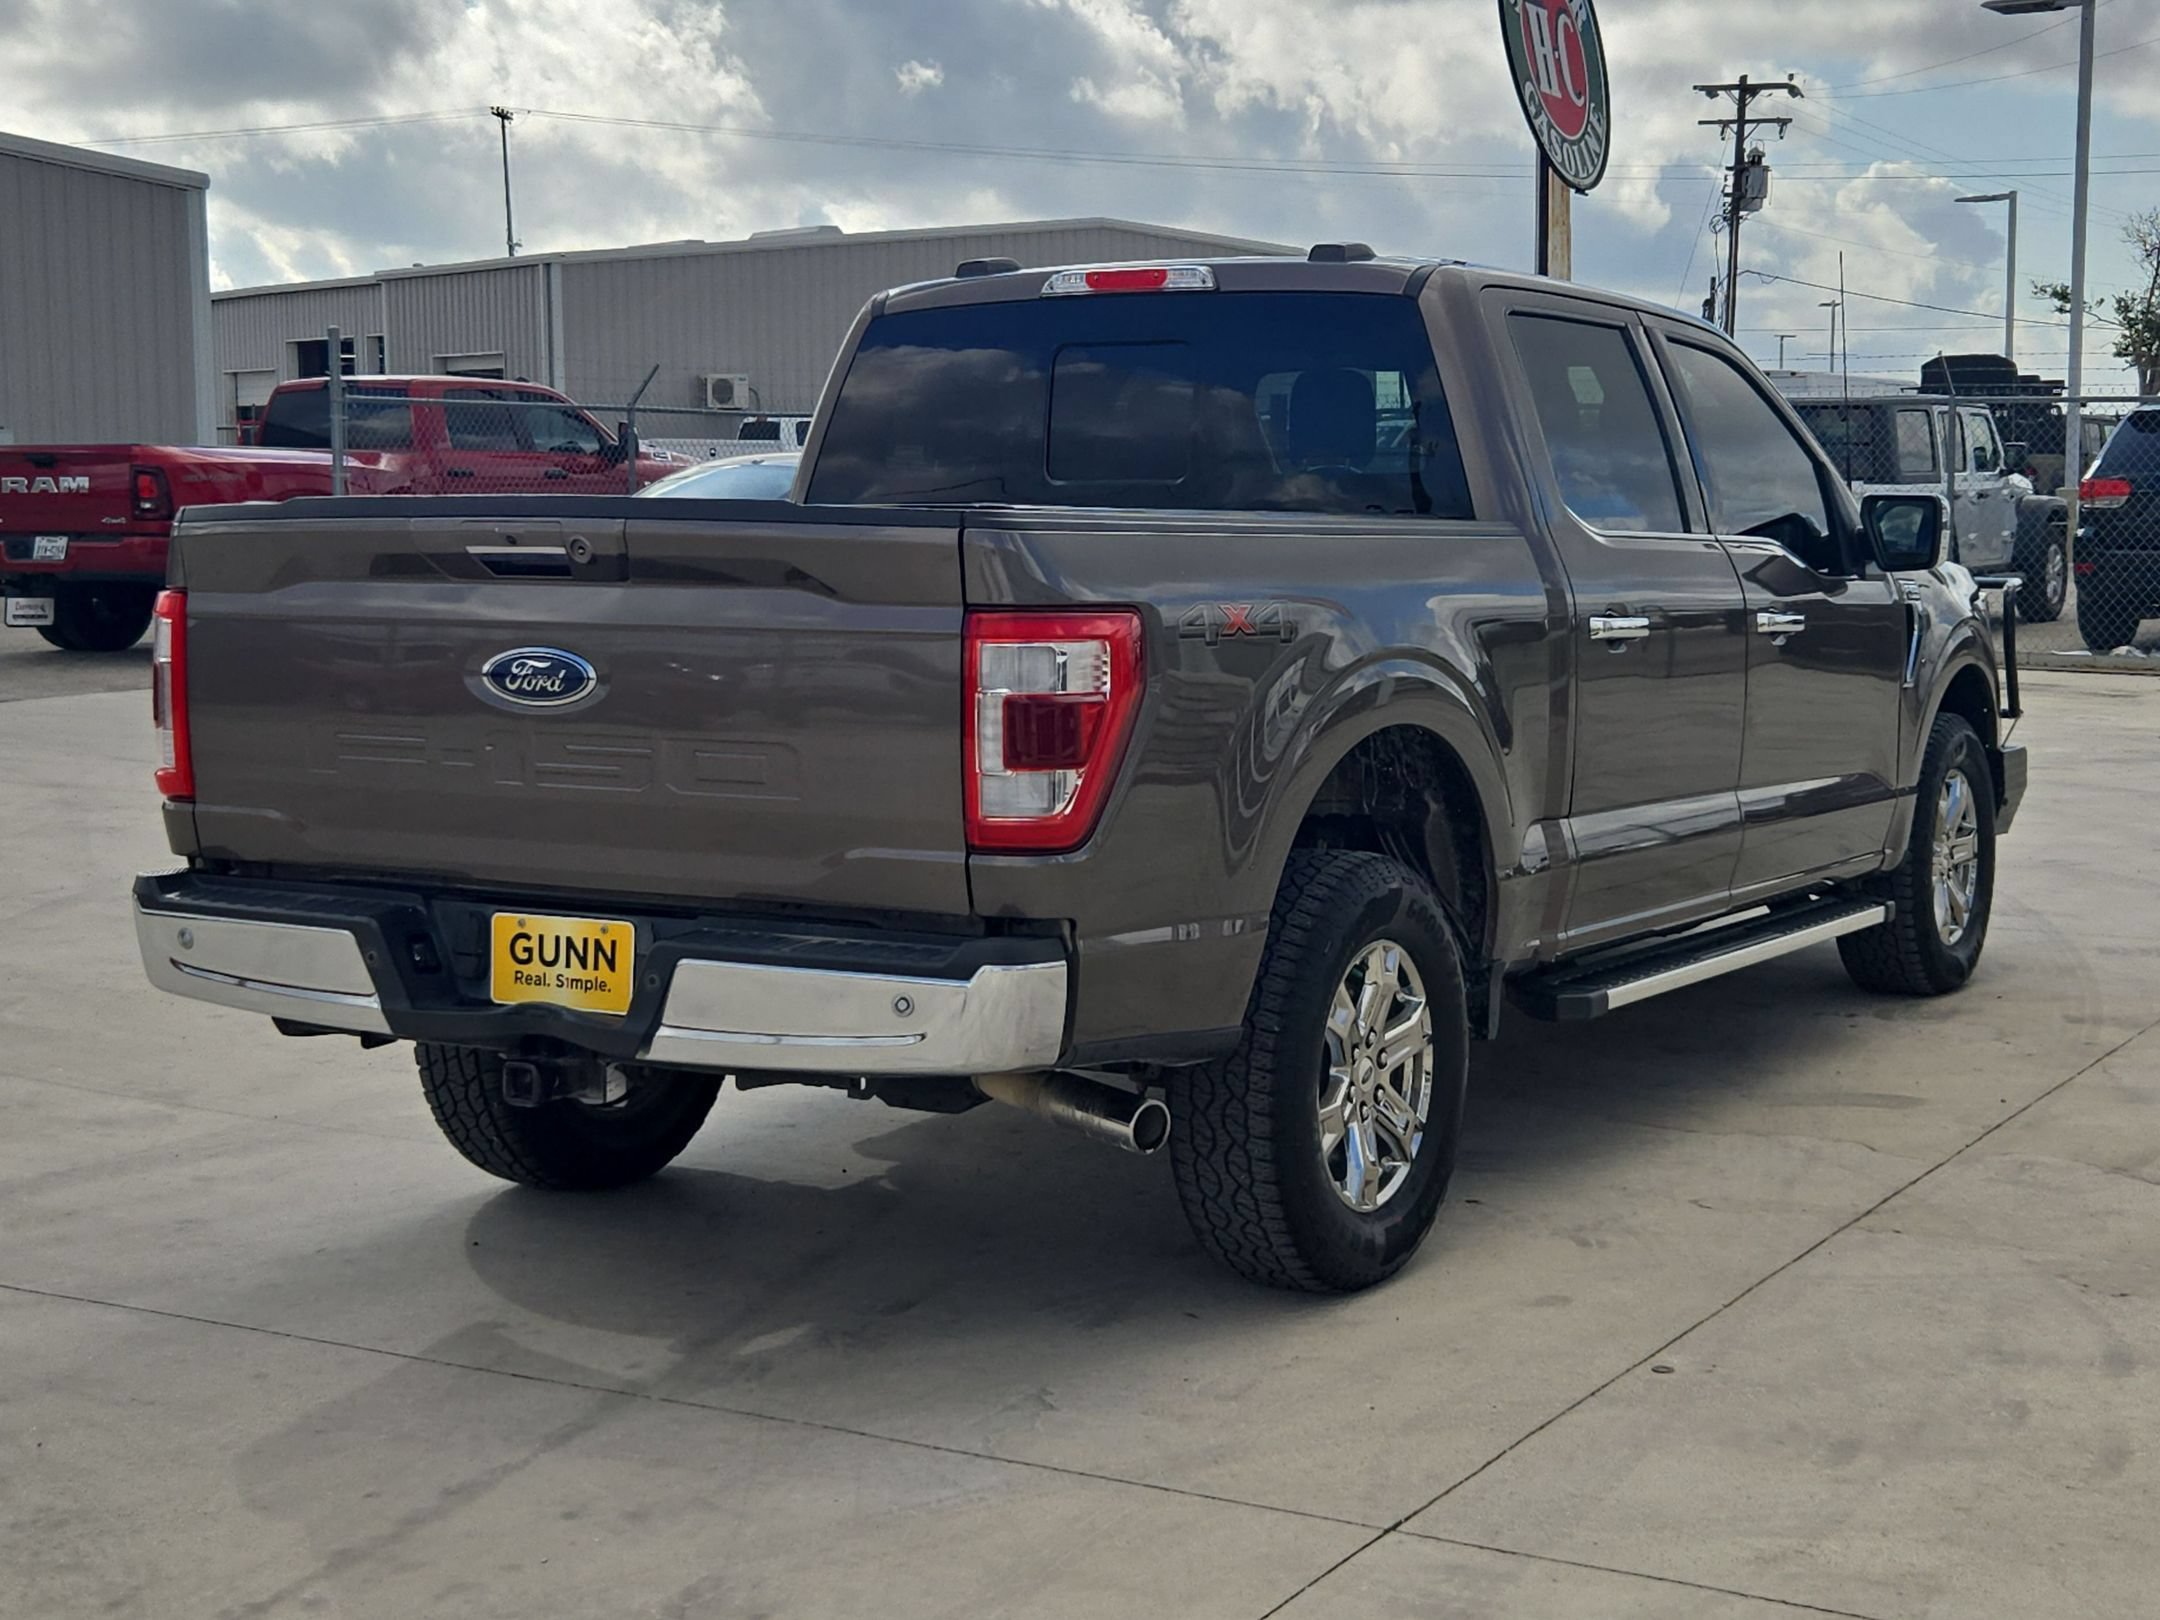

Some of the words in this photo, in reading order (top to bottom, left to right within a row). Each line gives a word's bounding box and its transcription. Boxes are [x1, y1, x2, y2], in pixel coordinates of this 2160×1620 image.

[1524, 81, 1603, 177] GASOLINE
[1, 476, 90, 493] RAM
[505, 658, 567, 692] Ford
[509, 932, 617, 973] GUNN
[514, 970, 550, 987] Real.
